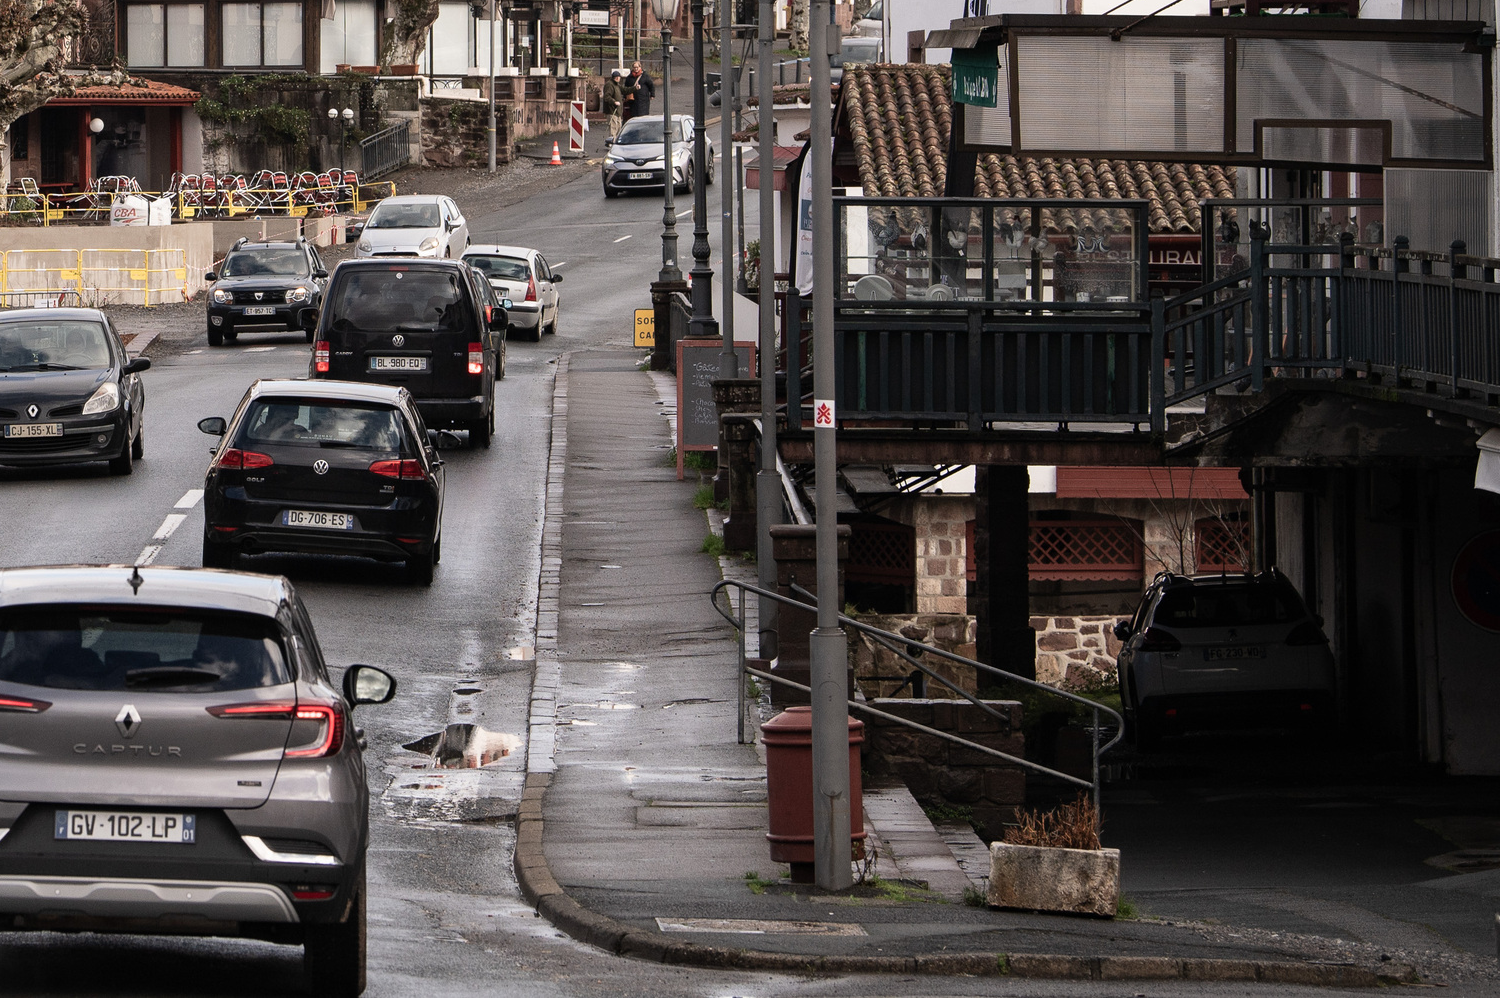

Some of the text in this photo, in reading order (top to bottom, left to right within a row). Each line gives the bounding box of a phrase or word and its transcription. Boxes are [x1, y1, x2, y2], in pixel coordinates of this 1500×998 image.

[114, 208, 136, 217] CBA
[639, 331, 655, 339] CA
[11, 425, 56, 436] CJ-155-XL
[290, 511, 345, 526] DG-706-ES
[73, 743, 182, 758] CAPTUR
[71, 814, 177, 838] GV-102-LP
[183, 828, 194, 840] 01
